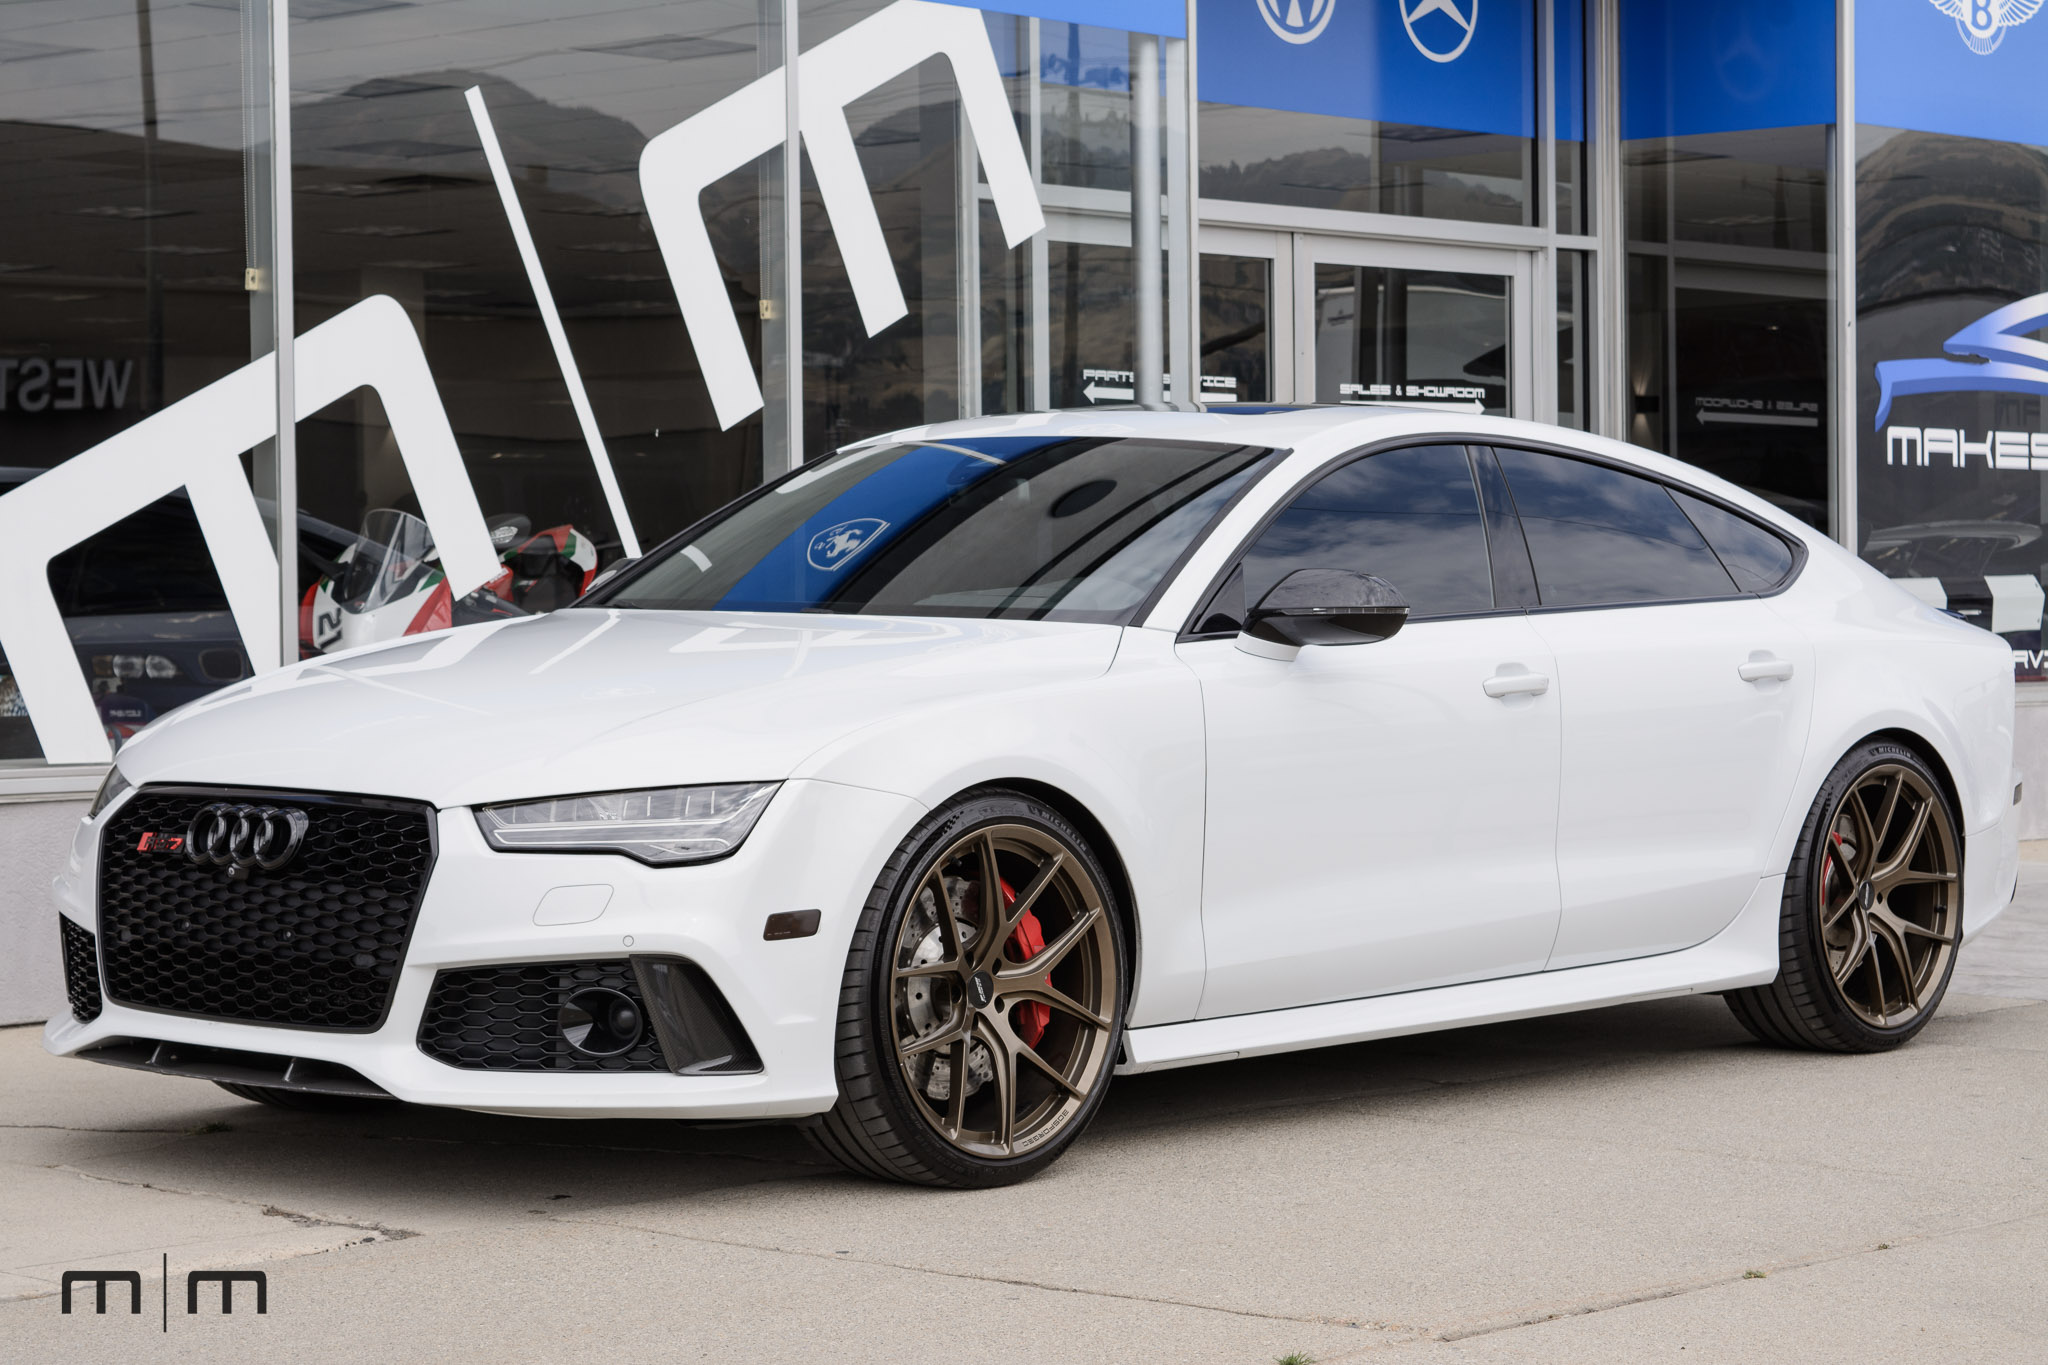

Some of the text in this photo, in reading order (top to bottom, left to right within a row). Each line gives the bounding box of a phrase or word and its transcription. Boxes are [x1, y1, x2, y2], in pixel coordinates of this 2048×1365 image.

[1340, 383, 1486, 399] SALES & SHOWROOM
[1879, 746, 1911, 758] MICHELIN
[1041, 811, 1087, 852] MICHELIN
